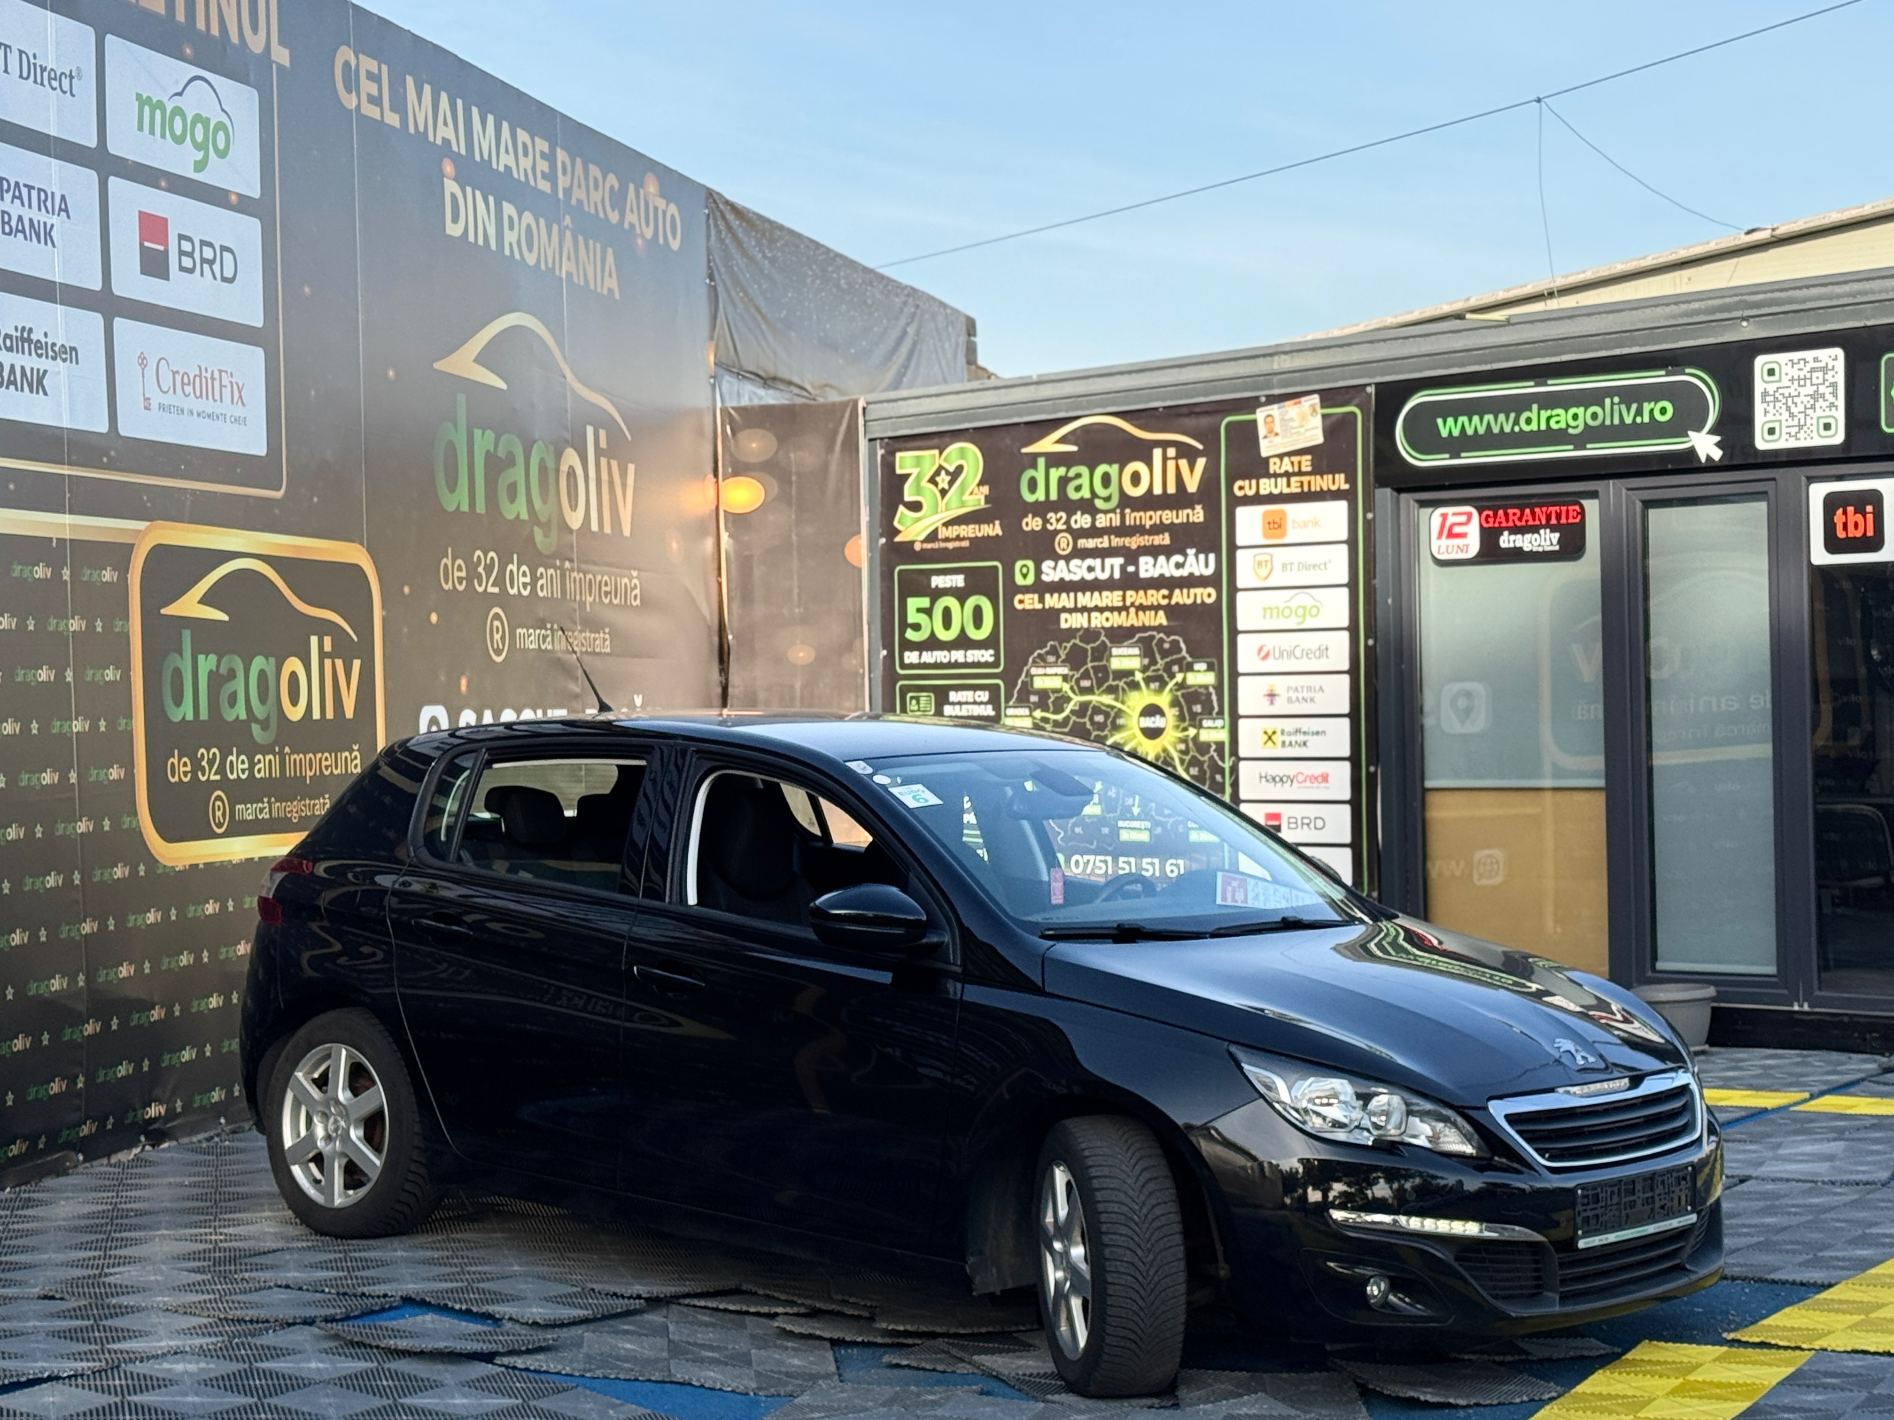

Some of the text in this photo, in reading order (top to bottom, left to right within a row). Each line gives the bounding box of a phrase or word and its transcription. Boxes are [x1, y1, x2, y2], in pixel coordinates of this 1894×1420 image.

[135, 92, 231, 173] mogo
[334, 45, 682, 251] CEL MAI MARE PARC AUTO
[0, 176, 71, 220] PATRIA
[1, 209, 56, 248] BANK
[443, 177, 620, 300] DIN ROMÂNIA
[178, 233, 238, 285] BRD
[0, 325, 79, 365] aiffeisen
[155, 357, 246, 407] CreditFix
[1436, 396, 1674, 438] www.dragoliv.ro
[433, 394, 635, 555] dragoliv
[1269, 455, 1312, 474] RATE
[893, 442, 984, 532] 32
[1020, 447, 1207, 510] dragoliv
[1233, 473, 1350, 497] CU BULETINUL
[1022, 504, 1205, 531] de 32 de ani împreună
[1267, 517, 1321, 531] tbi bank
[1436, 511, 1473, 541] 12
[1480, 504, 1582, 528] GARANTIE
[1834, 504, 1875, 539] tbi
[1077, 535, 1109, 549] marcă
[1110, 532, 1170, 549] înregistrată
[1437, 544, 1470, 555] LUNI
[1499, 528, 1560, 552] dragoliv
[1041, 557, 1125, 582] SASCUT
[1138, 548, 1216, 579] BACĂU
[1281, 562, 1295, 573] BT
[440, 547, 641, 612] de 32 de ani împreună
[931, 574, 965, 588] PESTE
[1014, 587, 1216, 610] CEL MAI MARE PARC AUTO
[904, 595, 994, 642] 500
[1060, 607, 1168, 629] DIN ROMÂNIA
[1262, 604, 1321, 626] mogo
[516, 623, 551, 651] marcă
[904, 649, 995, 664] DE AUTO PE STOC
[1273, 644, 1330, 661] UniCredit
[161, 629, 361, 744] dragoliv
[949, 690, 989, 702] RATE CU
[1287, 685, 1325, 694] PATRIA
[1287, 696, 1316, 705] BANK
[1280, 727, 1326, 737] Raiffeisen
[1281, 740, 1309, 748] BANK
[166, 744, 362, 784] de 32 de ani împreună
[1259, 771, 1330, 787] HappyCredit
[235, 797, 270, 821] marcă
[272, 794, 331, 823] înregistrată
[911, 794, 929, 804] 6
[1287, 816, 1326, 830] BRD
[1070, 854, 1185, 878] 0751 51 51 61
